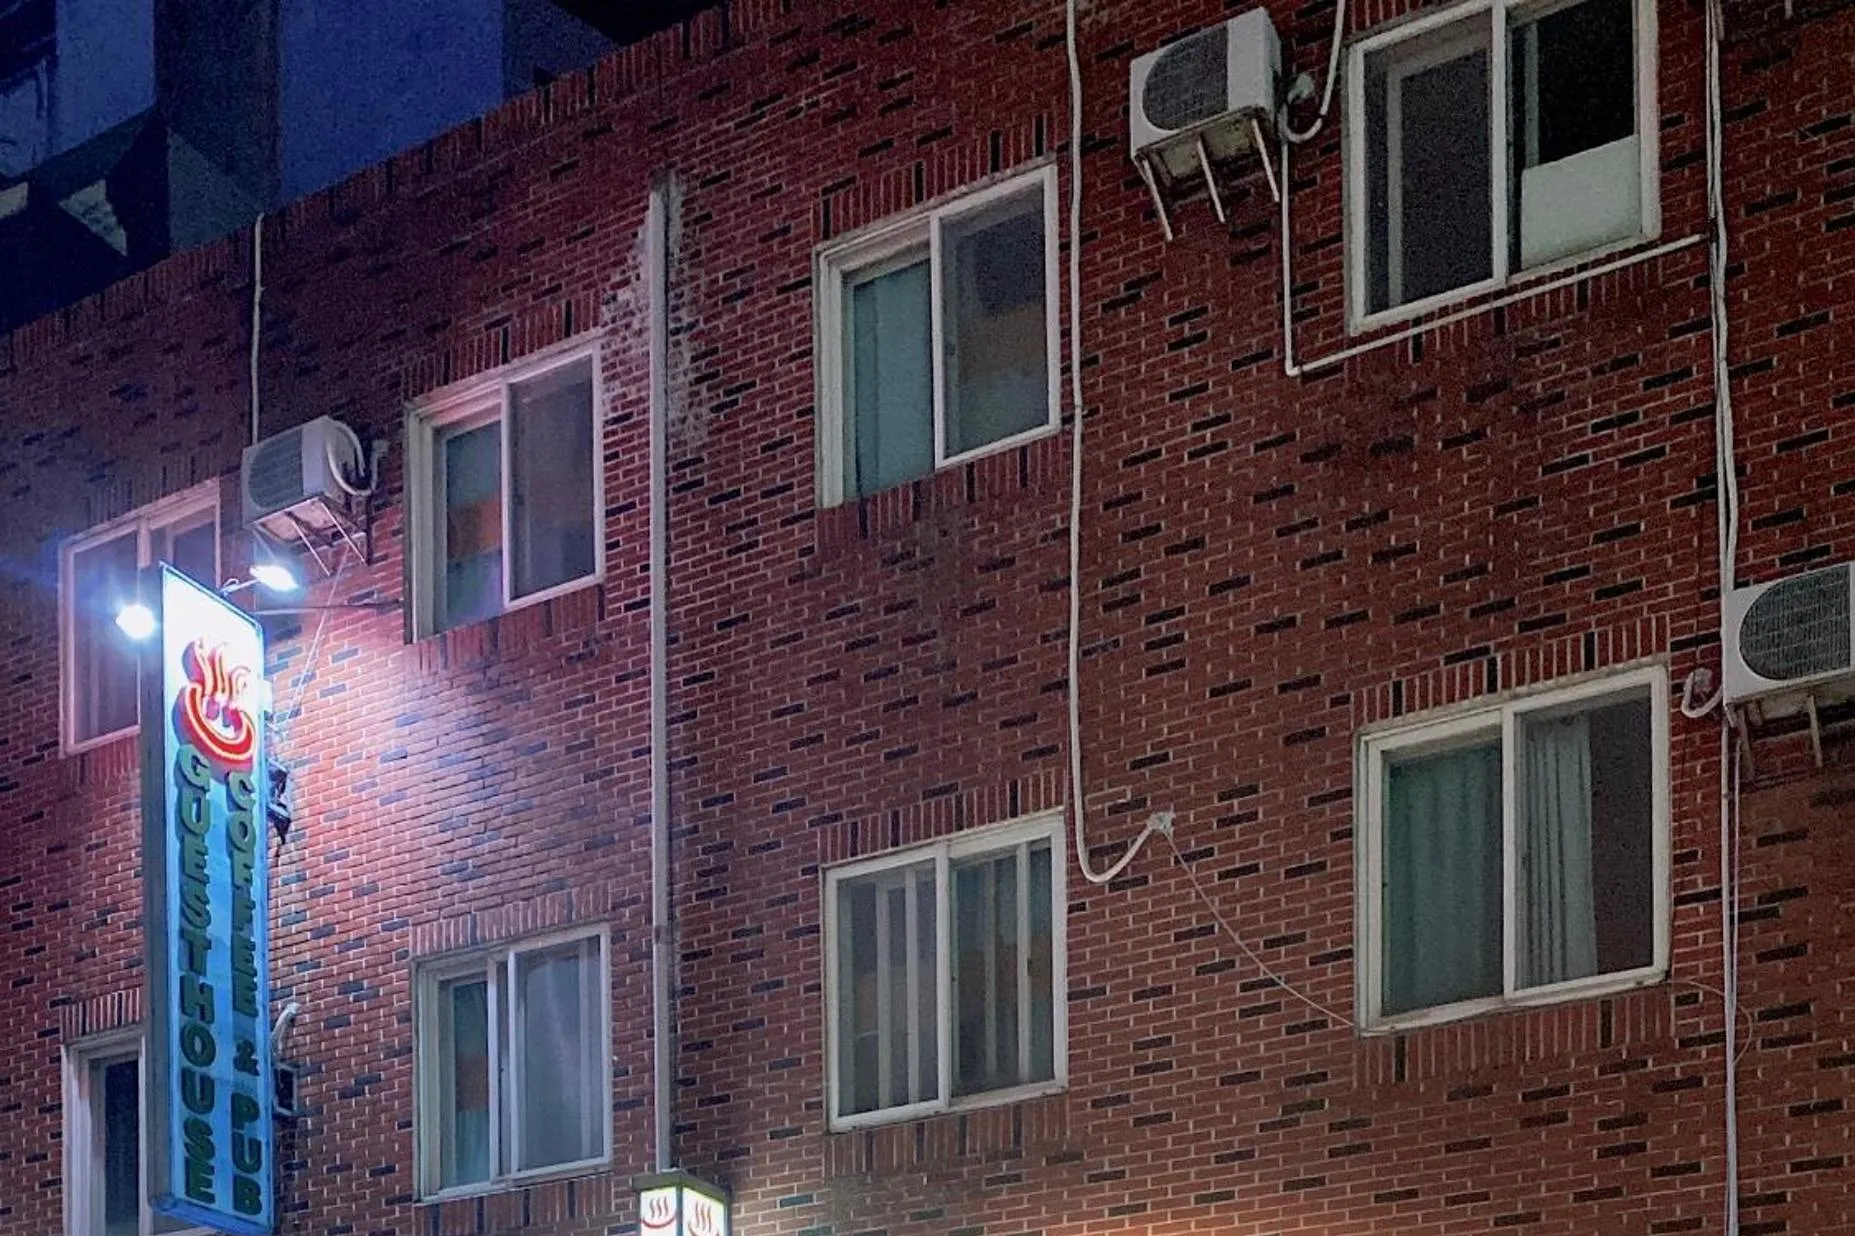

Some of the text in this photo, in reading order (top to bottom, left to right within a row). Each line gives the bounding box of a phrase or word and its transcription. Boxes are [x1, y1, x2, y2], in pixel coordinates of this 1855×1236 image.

[224, 770, 262, 1216] COFFEE & PUB
